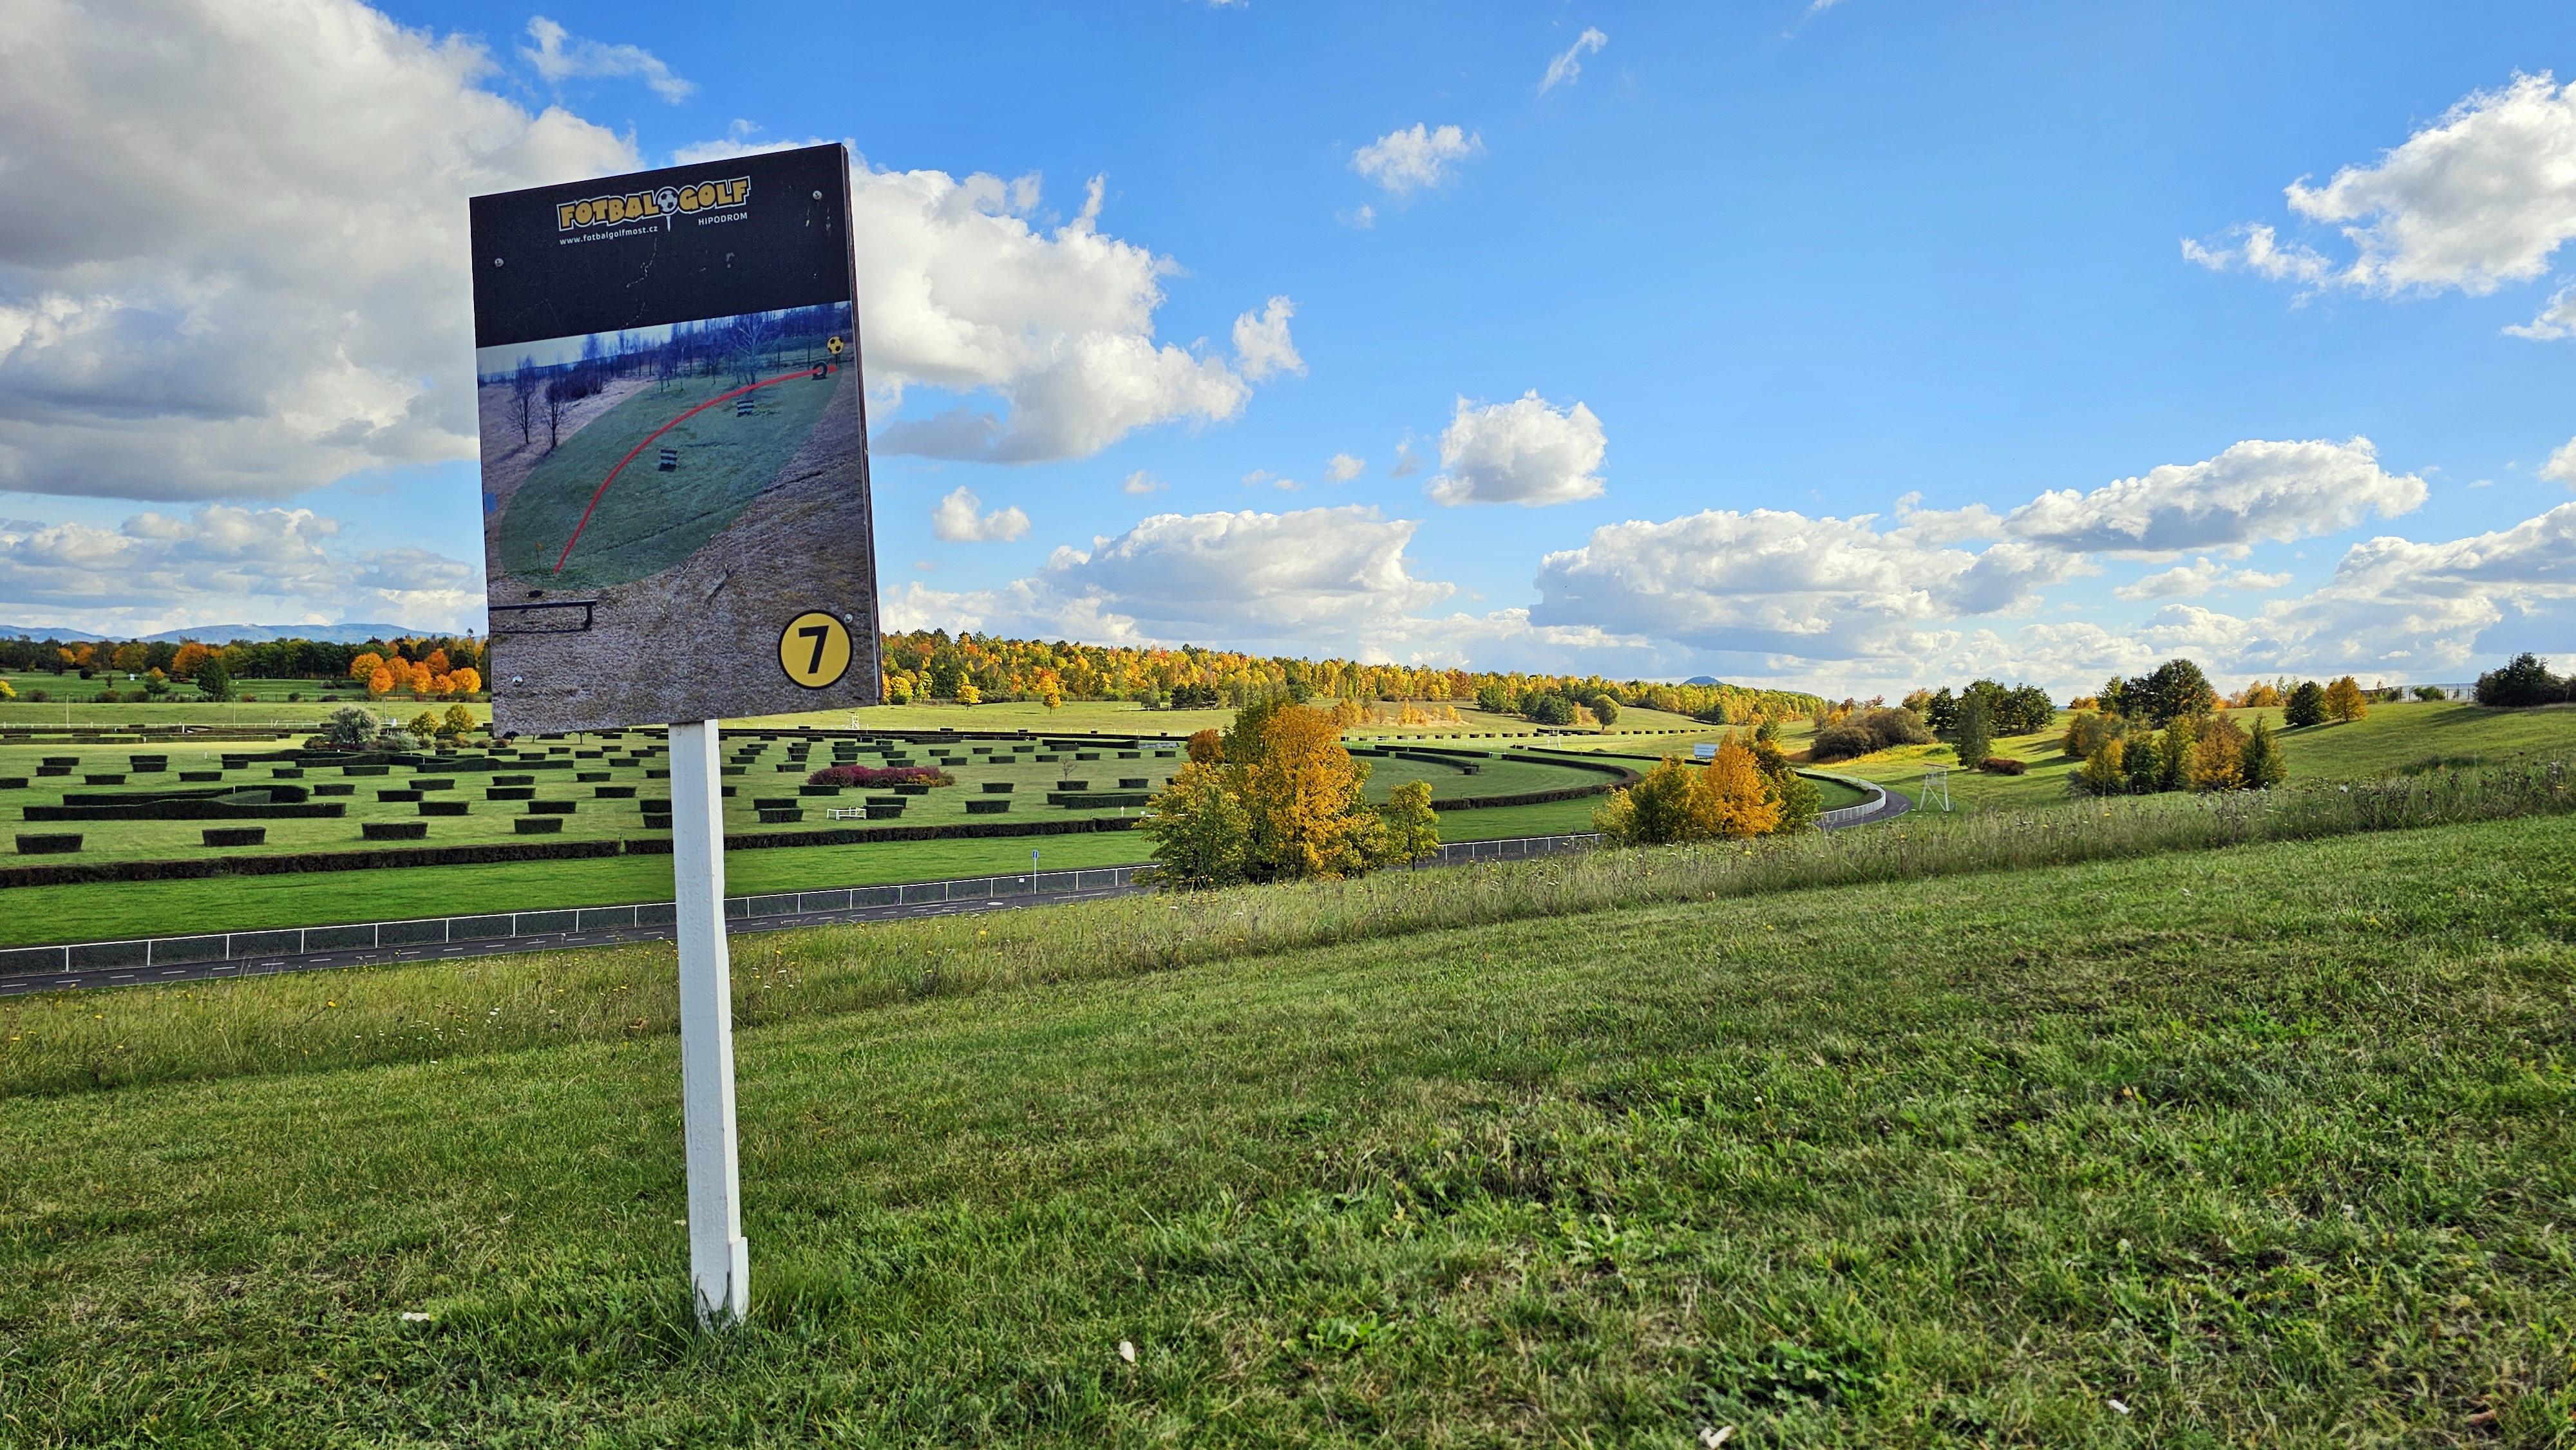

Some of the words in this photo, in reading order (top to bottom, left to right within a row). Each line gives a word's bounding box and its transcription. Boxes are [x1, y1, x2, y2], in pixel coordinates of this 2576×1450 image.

[557, 191, 659, 231] FOTBAL
[678, 176, 750, 213] GOLF
[698, 212, 748, 225] HIPODROM
[560, 226, 658, 245] www.fotbalgolfmost.cz
[799, 625, 829, 674] 7
